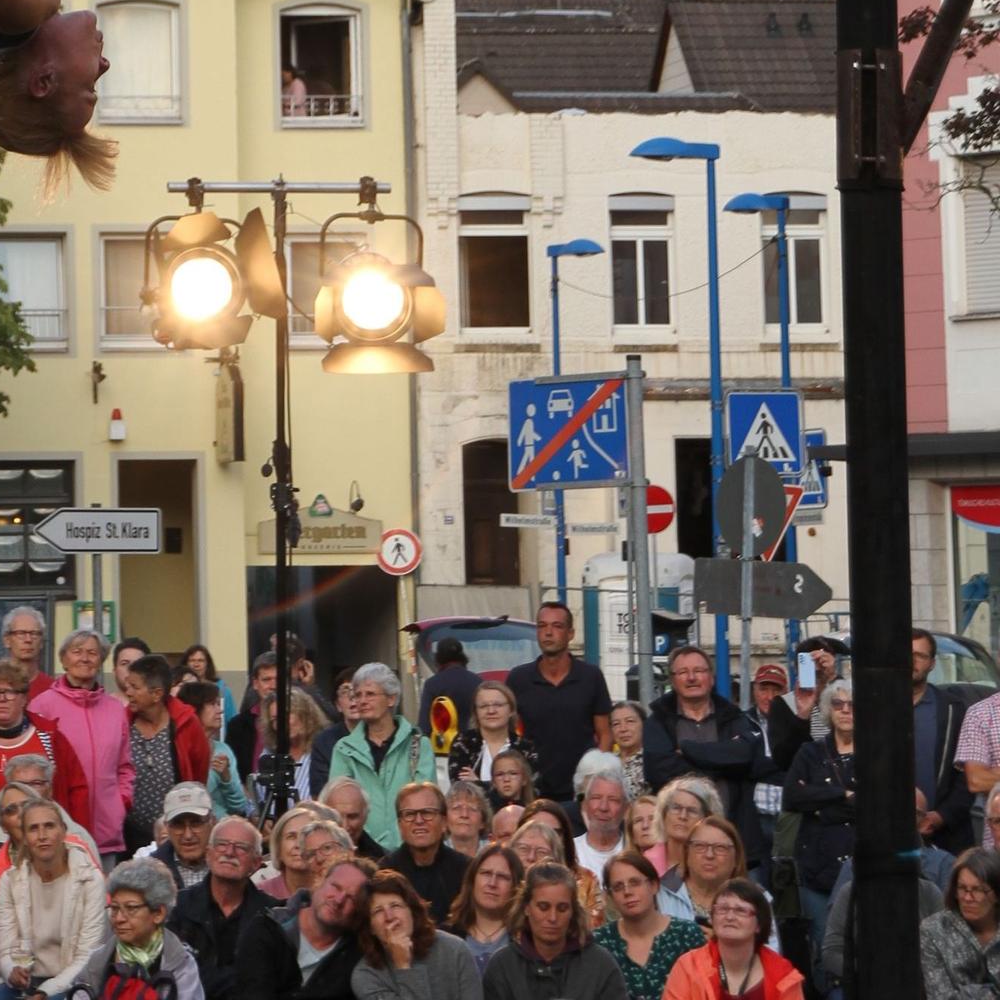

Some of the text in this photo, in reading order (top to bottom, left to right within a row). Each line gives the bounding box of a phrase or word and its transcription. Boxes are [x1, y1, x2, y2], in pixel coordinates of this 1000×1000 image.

[65, 521, 102, 543] Hospiz
[121, 521, 149, 539] Klara
[655, 635, 665, 652] P
